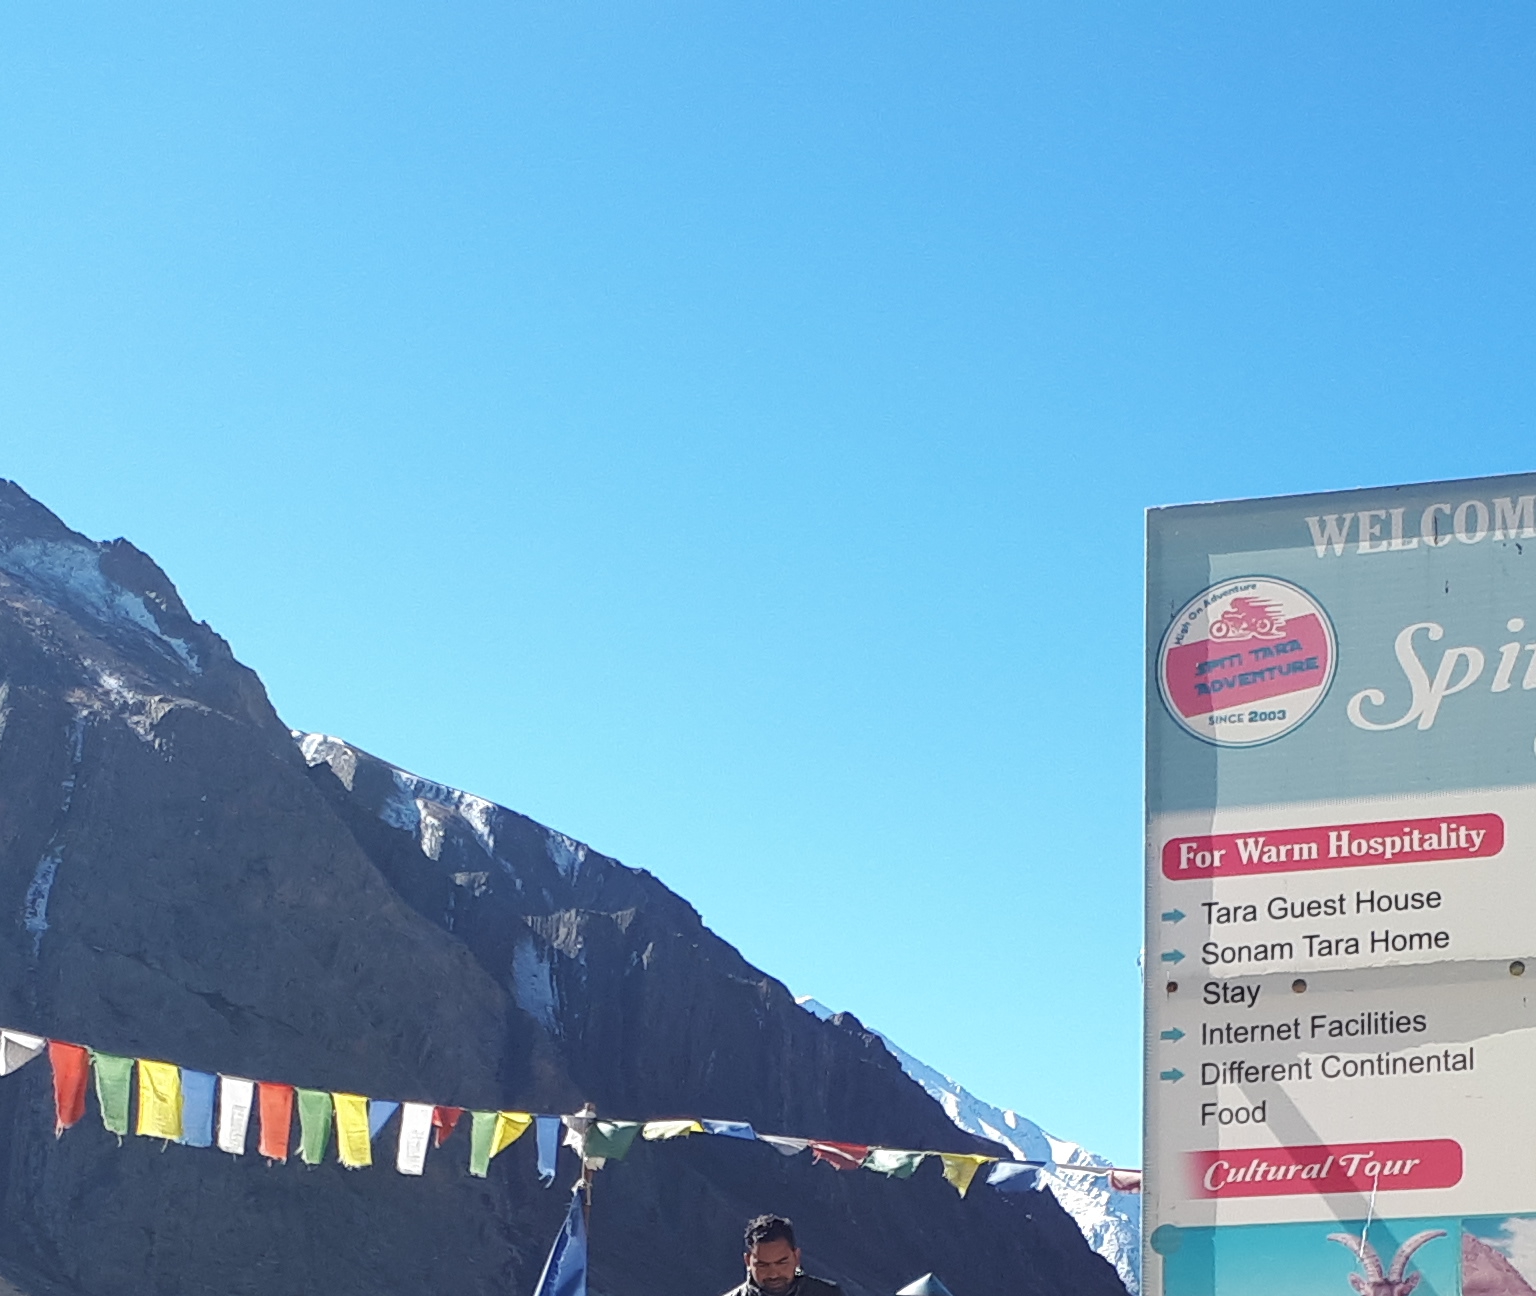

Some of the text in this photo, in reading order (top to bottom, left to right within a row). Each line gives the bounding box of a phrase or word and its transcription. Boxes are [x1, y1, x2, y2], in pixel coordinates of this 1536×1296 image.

[1174, 619, 1190, 646] High
[1188, 606, 1203, 620] On
[1249, 639, 1303, 660] TARA
[1208, 709, 1287, 725] SINCE 2003
[1178, 824, 1486, 870] For Warm Hospitality
[1202, 890, 1442, 924] Tara Guest House
[1202, 930, 1450, 965] Sonam Tara Home
[1203, 981, 1262, 1008] Stay
[1202, 1011, 1427, 1046] Internet Facilities
[1202, 1048, 1475, 1086] Different Continental
[1202, 1101, 1266, 1126] Food
[1203, 1151, 1421, 1191] Cultural Tour
